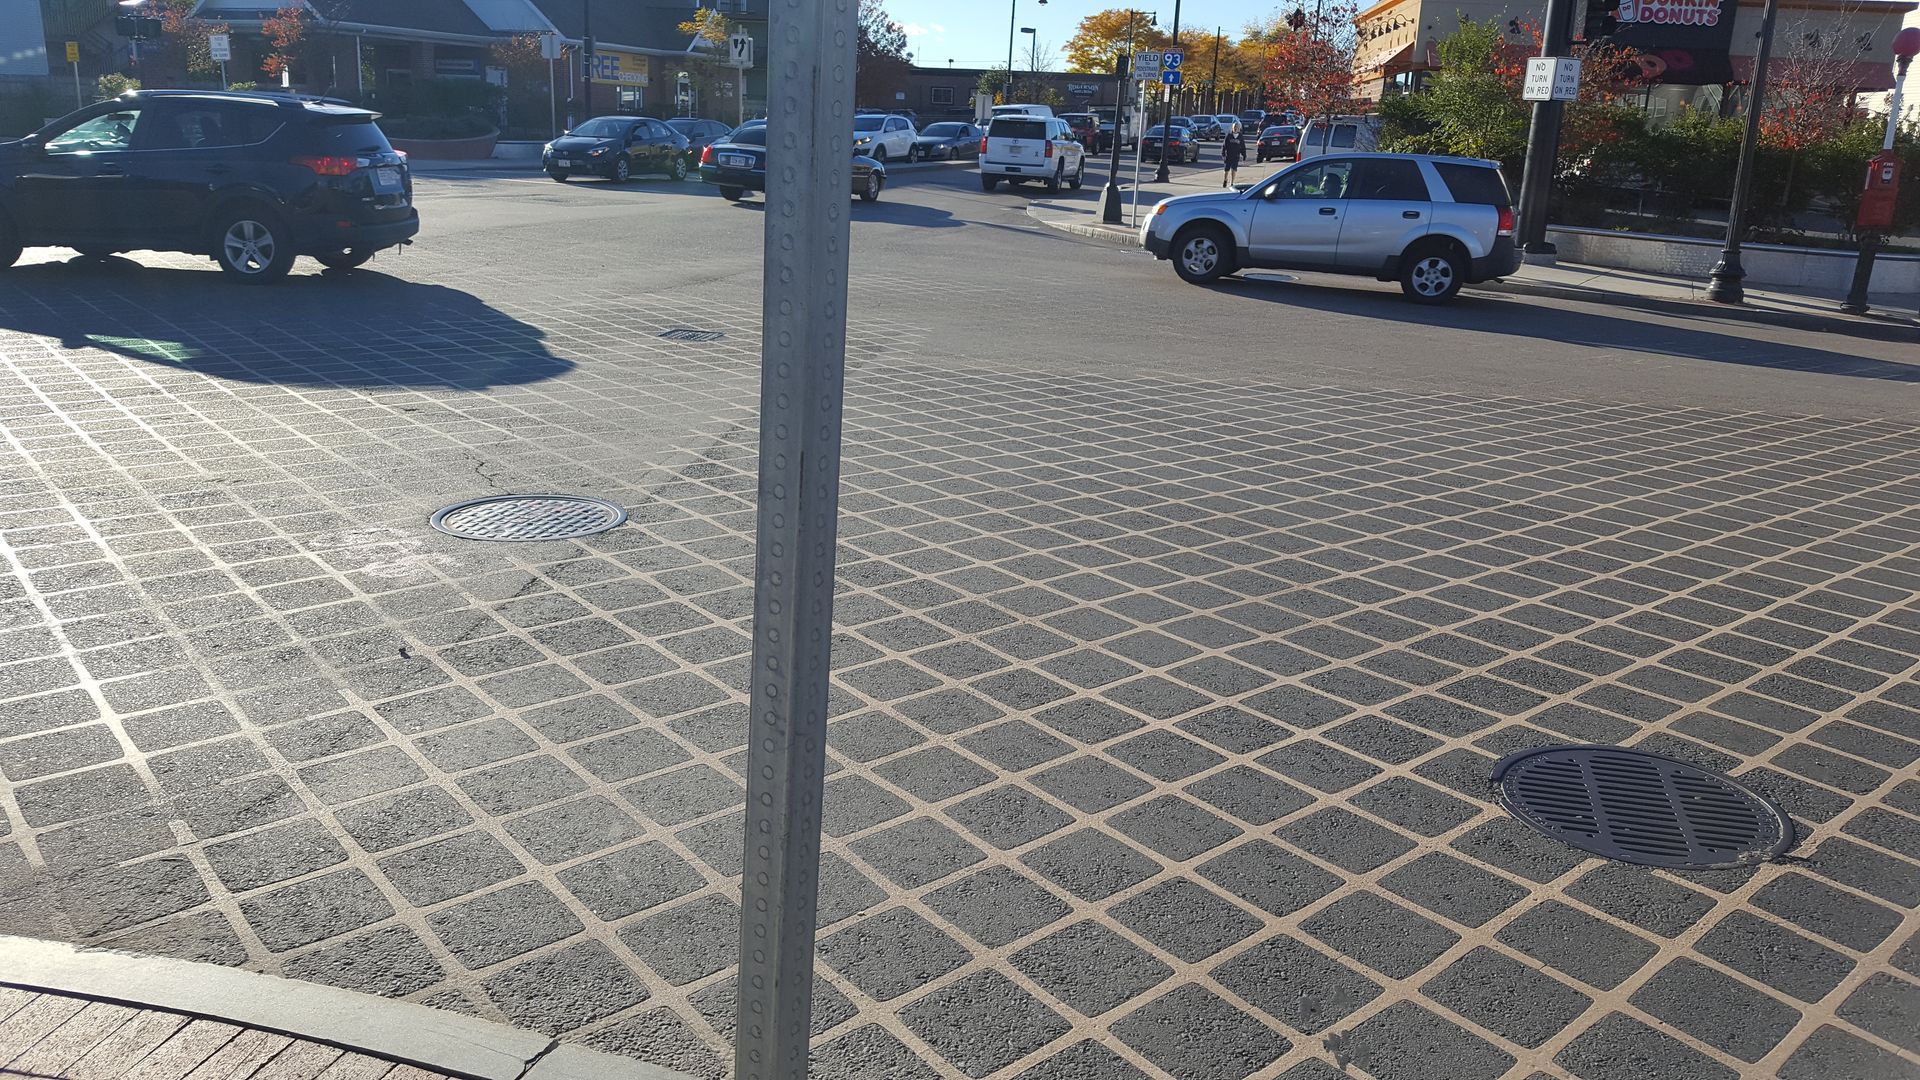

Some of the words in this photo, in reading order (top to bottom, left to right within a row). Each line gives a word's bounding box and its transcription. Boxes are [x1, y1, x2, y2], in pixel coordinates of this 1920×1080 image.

[1641, 7, 1720, 24] DONUTS
[1164, 53, 1180, 66] 93
[1536, 63, 1546, 71] NO
[1564, 63, 1573, 71] NO
[1526, 86, 1534, 94] ON
[1537, 86, 1549, 95] RED
[1555, 86, 1563, 94] ON
[1565, 86, 1577, 95] RED
